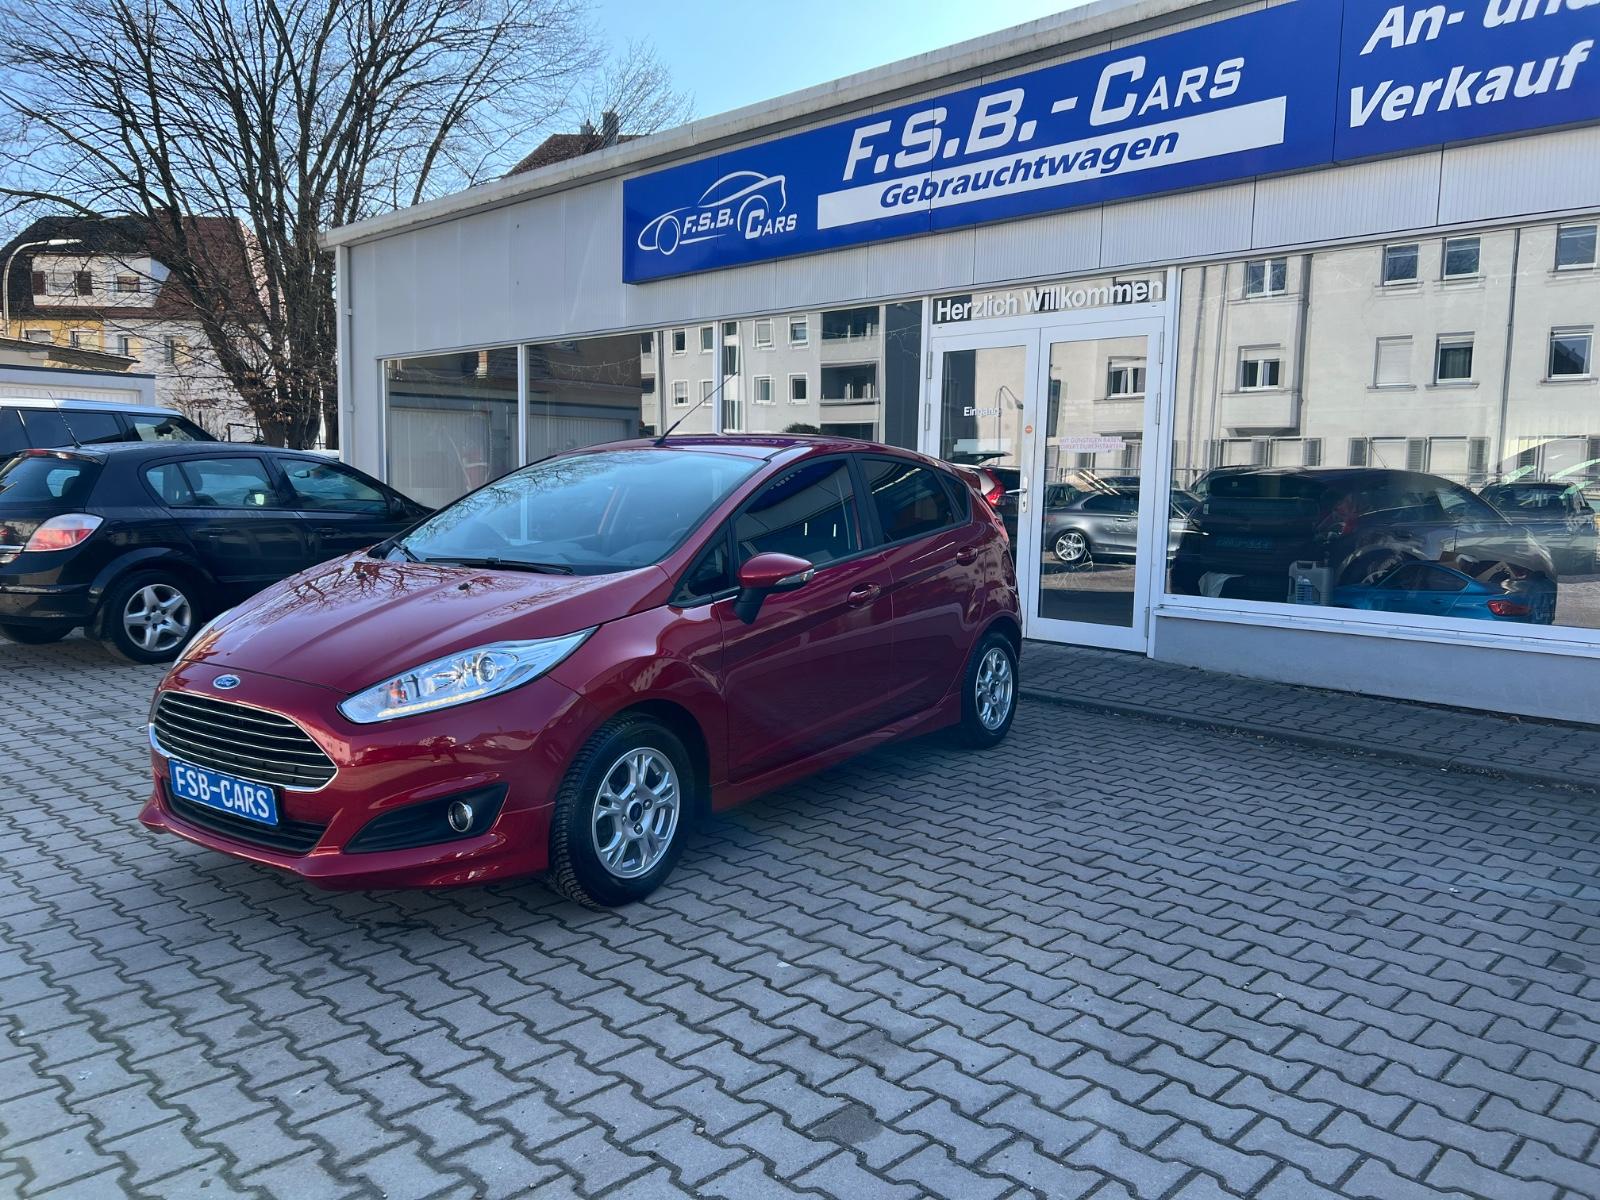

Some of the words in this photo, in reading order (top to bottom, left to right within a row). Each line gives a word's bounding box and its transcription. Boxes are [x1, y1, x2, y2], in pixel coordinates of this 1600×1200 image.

[1360, 5, 1465, 56] An-
[1483, 0, 1600, 29] un
[1350, 39, 1594, 128] Verkauf
[880, 130, 1180, 208] Gebrauchtwagen
[682, 208, 734, 235] F.S.B.
[937, 294, 1018, 322] Herzlich
[1023, 280, 1163, 312] Willkommen
[963, 406, 1001, 418] Eingang
[174, 766, 269, 818] FSB-CARS
